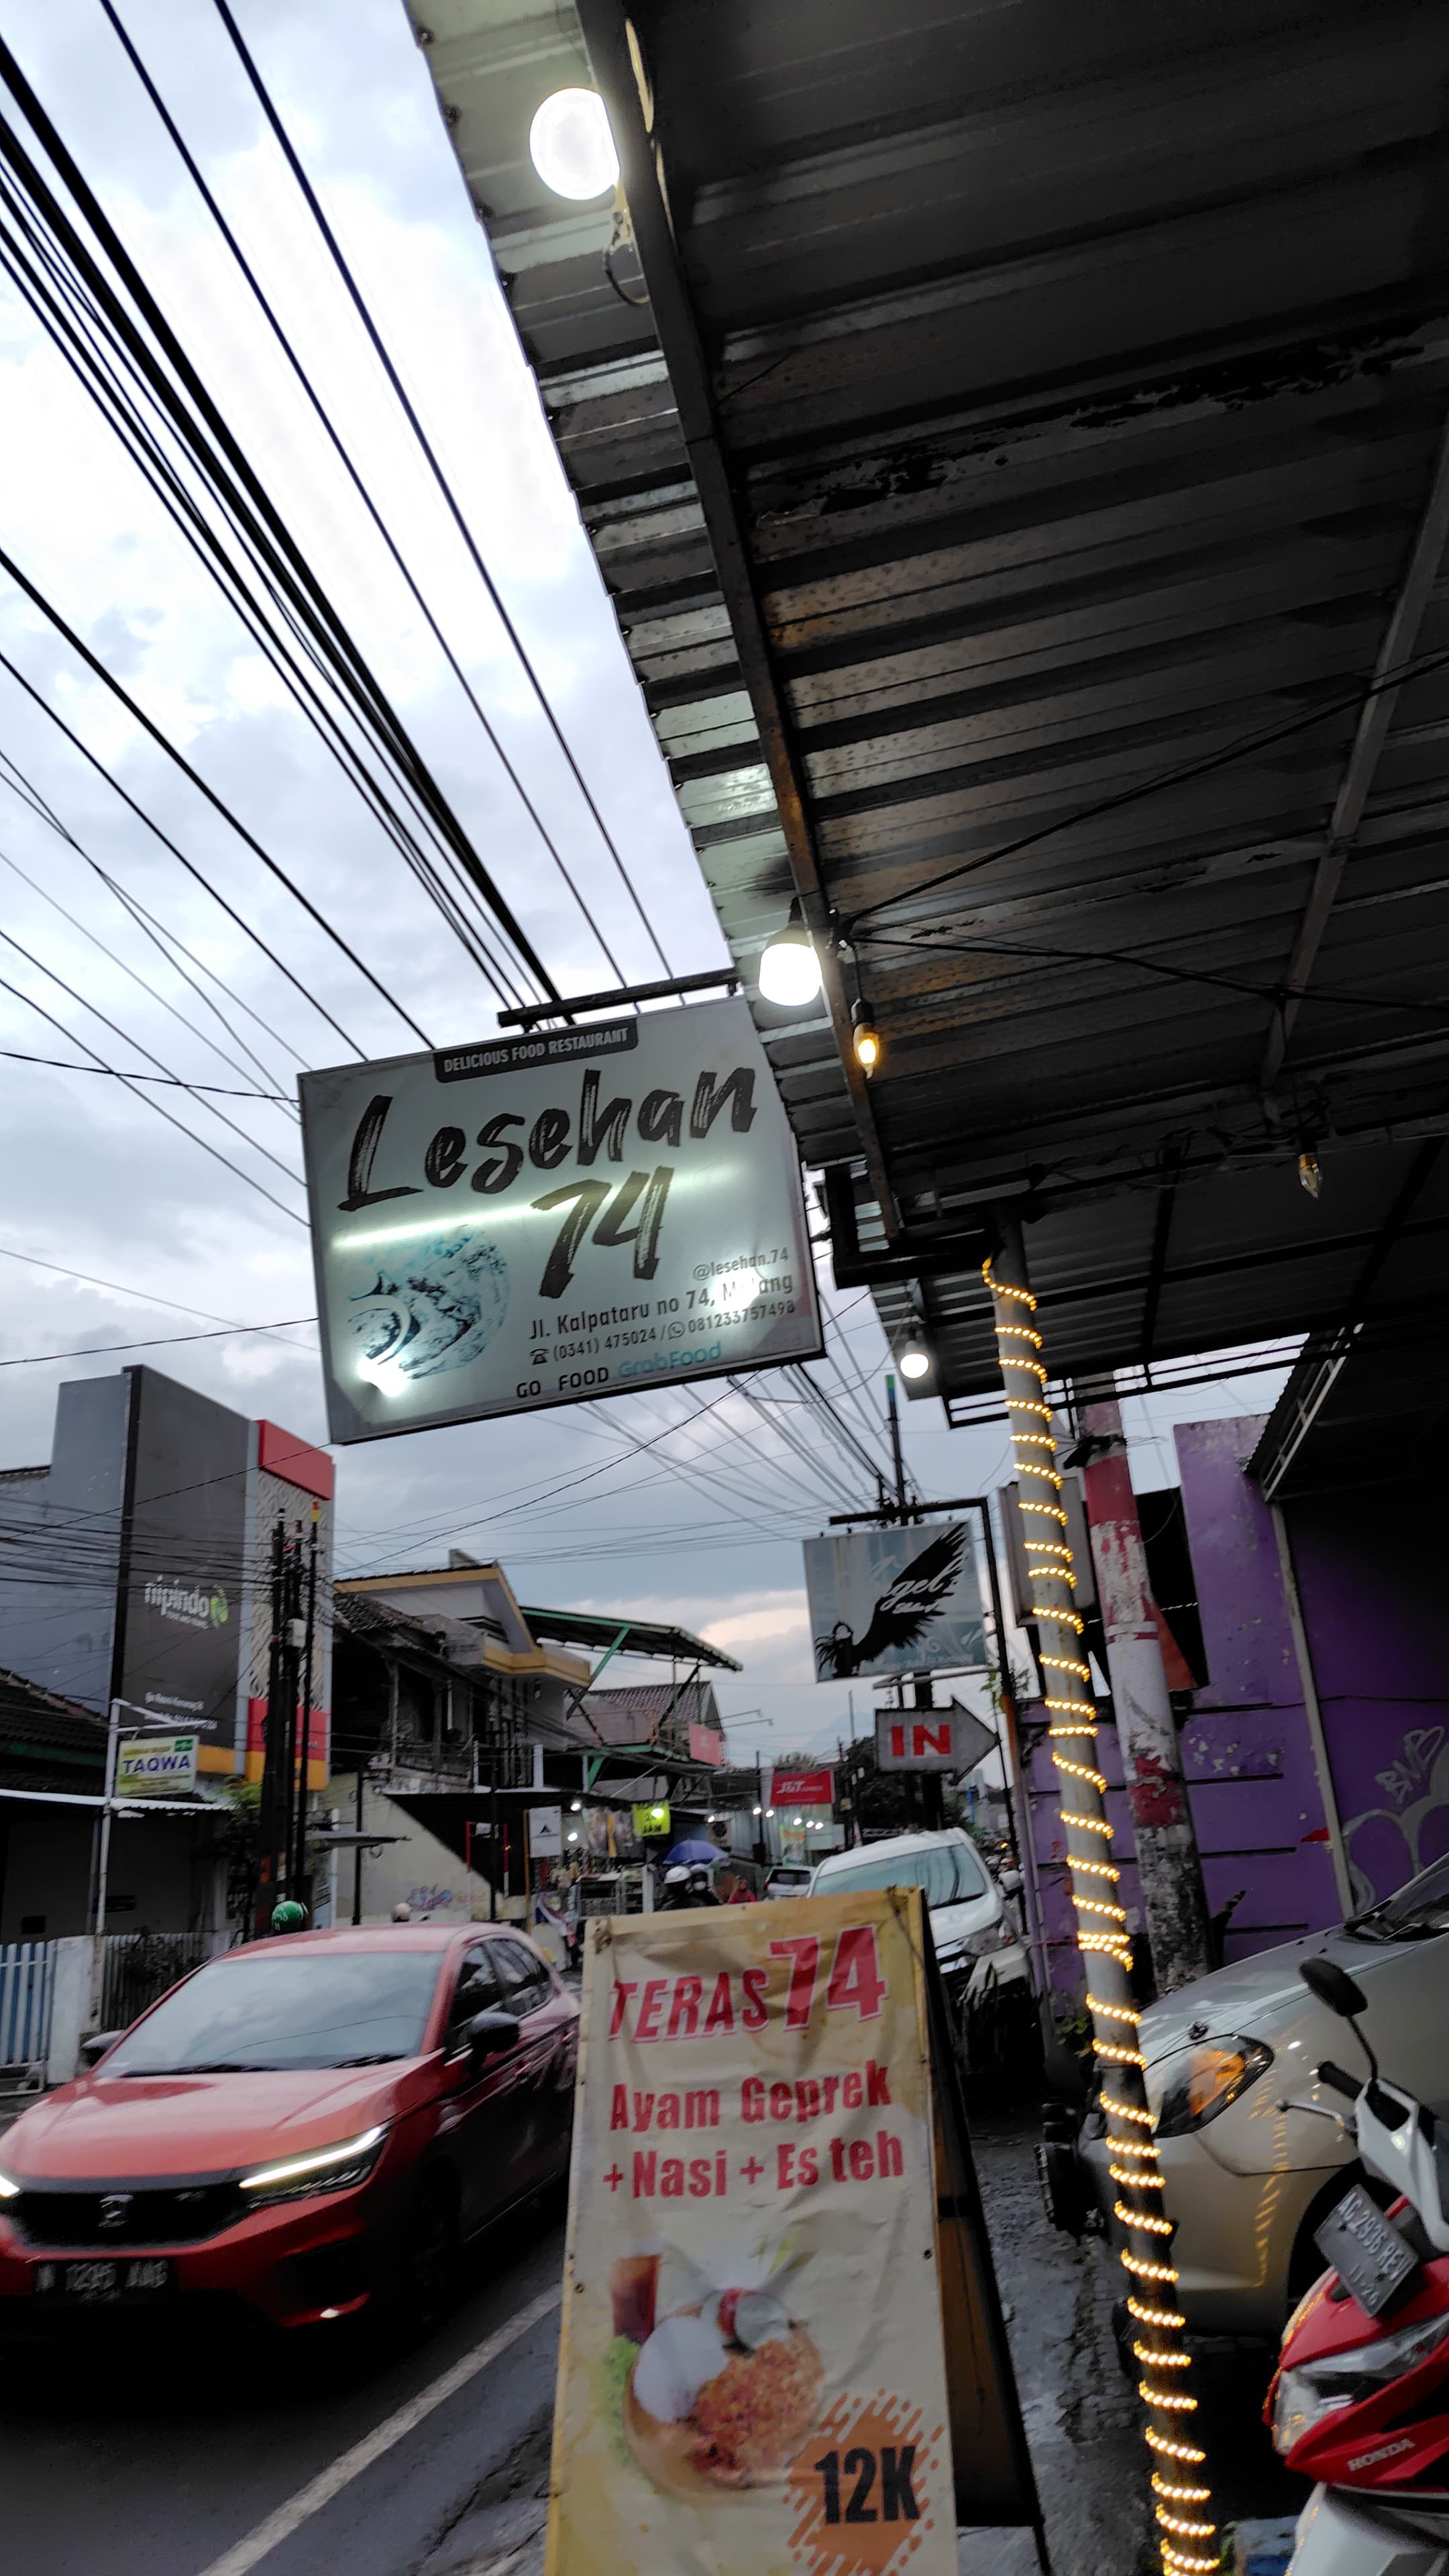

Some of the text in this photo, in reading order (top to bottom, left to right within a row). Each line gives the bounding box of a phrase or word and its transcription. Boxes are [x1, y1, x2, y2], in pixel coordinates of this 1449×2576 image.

[443, 1027, 629, 1073] DELICIOUS FOOD RESTAURANT
[337, 1067, 757, 1212] Lesehan
[531, 1165, 675, 1299] 74
[693, 1246, 789, 1281] @lesehan.74
[557, 1302, 649, 1335] Kalpataru
[657, 1297, 680, 1316] no
[686, 1287, 716, 1309] 74,
[722, 1274, 793, 1301] Mang
[516, 1341, 722, 1399] GO FOOD GrabFood
[553, 1337, 600, 1362] (0341)
[604, 1327, 657, 1350] 475024
[121, 1754, 191, 1774] TAQWA
[891, 1723, 951, 1758] IN
[607, 1923, 890, 2044] TERAS 74
[609, 2059, 892, 2133] Ayam Geprek
[777, 2143, 820, 2190] Es
[829, 2129, 904, 2184] teh
[814, 2445, 921, 2524] 12K
[1346, 2438, 1416, 2472] HONDA
